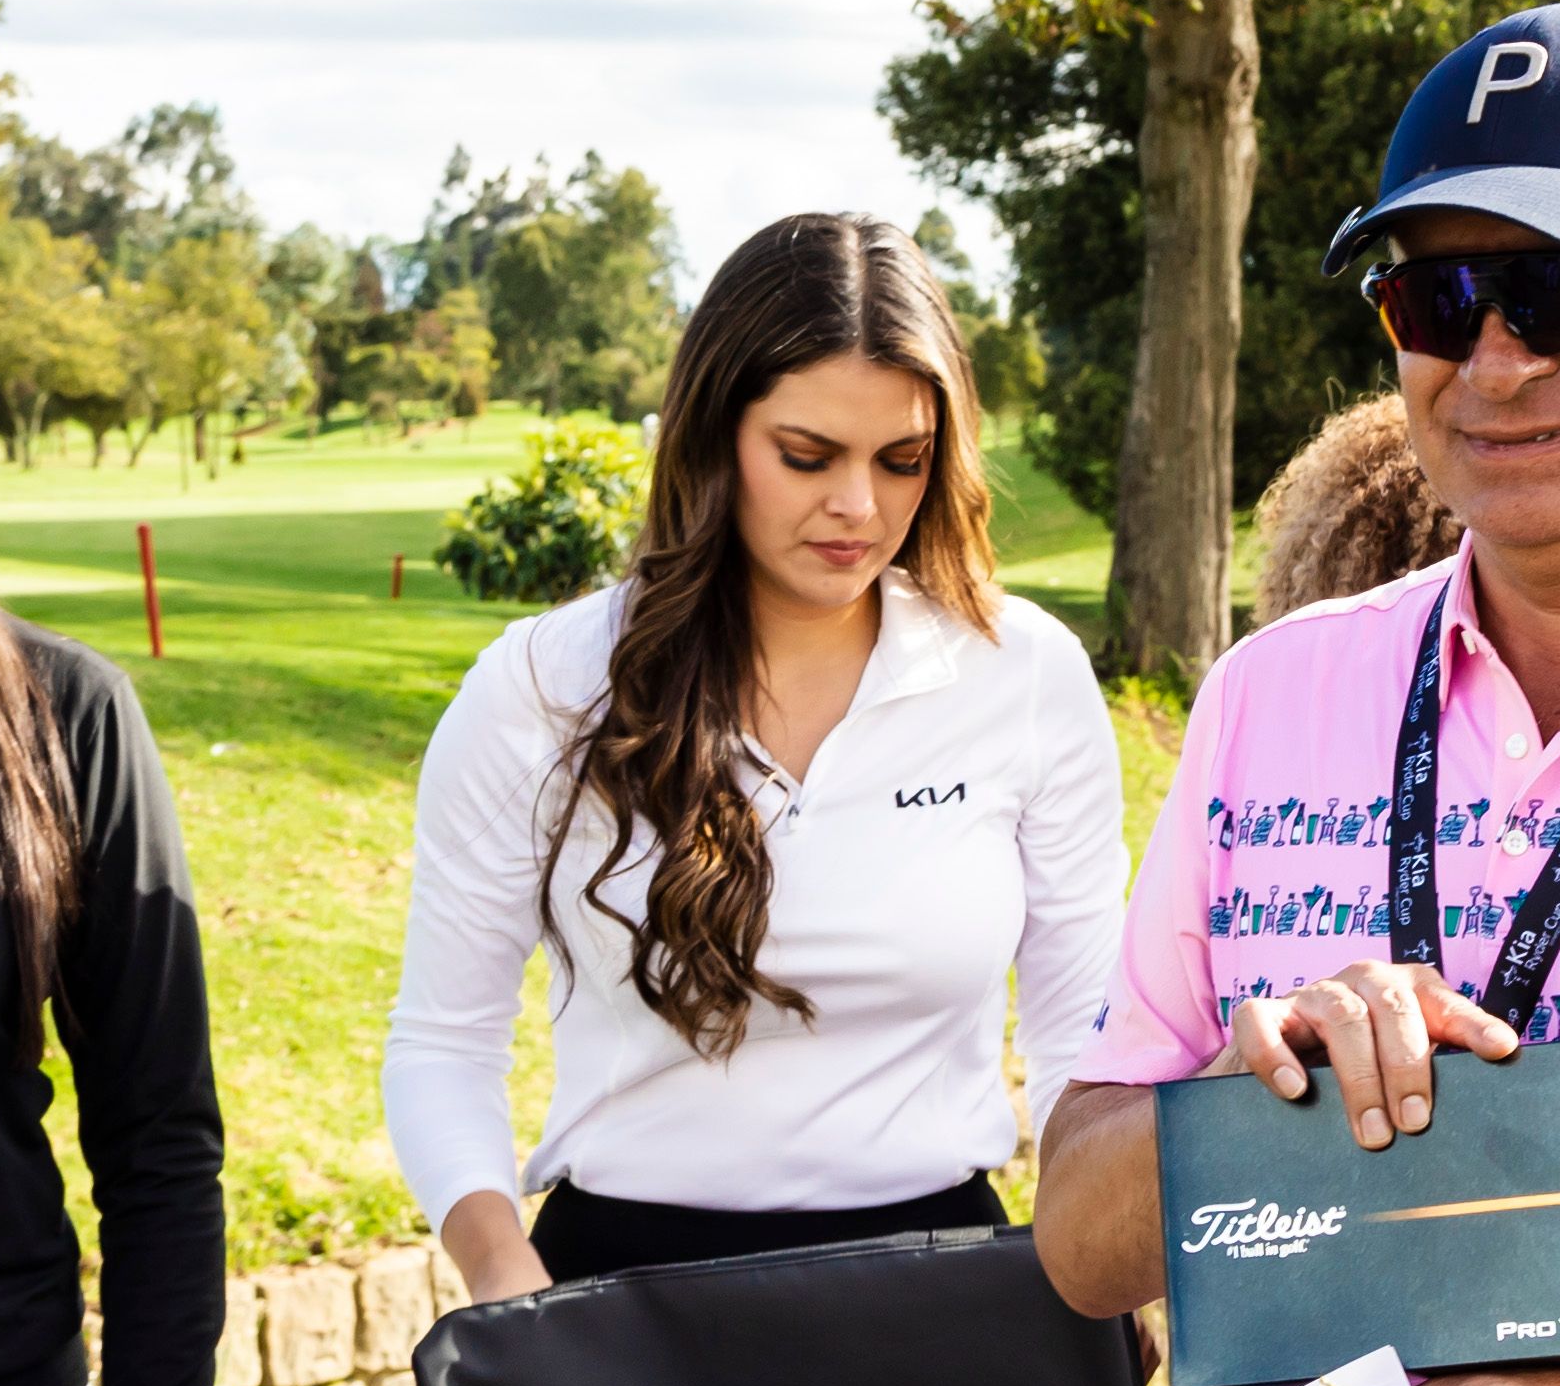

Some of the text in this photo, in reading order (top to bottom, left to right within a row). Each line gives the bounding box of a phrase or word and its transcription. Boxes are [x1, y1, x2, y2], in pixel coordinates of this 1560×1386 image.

[1466, 41, 1549, 124] P
[1415, 749, 1433, 785] Kia
[1401, 754, 1416, 821] Ryder Cup
[1397, 855, 1413, 895] Ryder
[1412, 851, 1430, 889] Kia
[1398, 896, 1414, 927] Cup
[1505, 929, 1537, 966] Kia
[1181, 1197, 1347, 1254] Titleist
[1264, 1241, 1279, 1256] in
